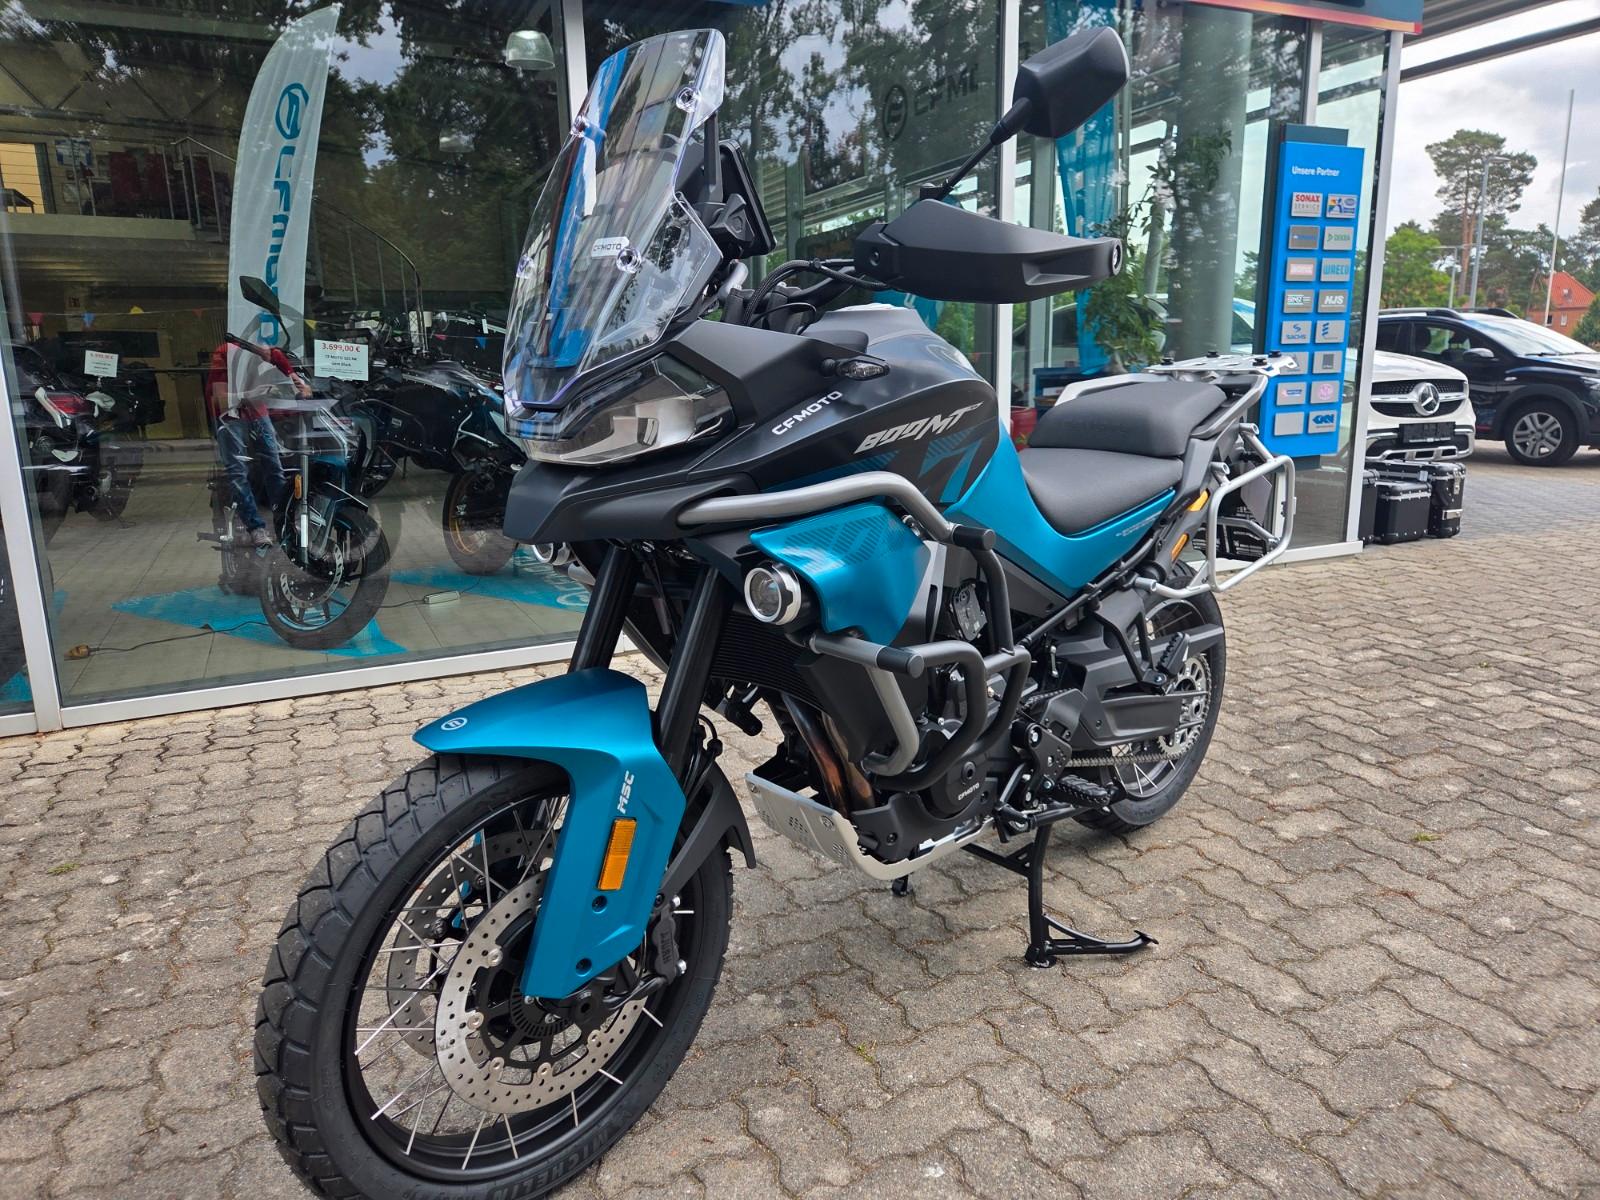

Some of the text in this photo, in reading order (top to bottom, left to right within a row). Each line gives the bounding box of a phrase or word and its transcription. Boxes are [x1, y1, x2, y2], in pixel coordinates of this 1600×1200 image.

[1292, 166, 1340, 177] Unsere Partner
[1295, 194, 1320, 203] SONAX
[771, 390, 843, 436] CFMOTO
[853, 401, 985, 455] 800MT
[616, 769, 635, 815] MSC
